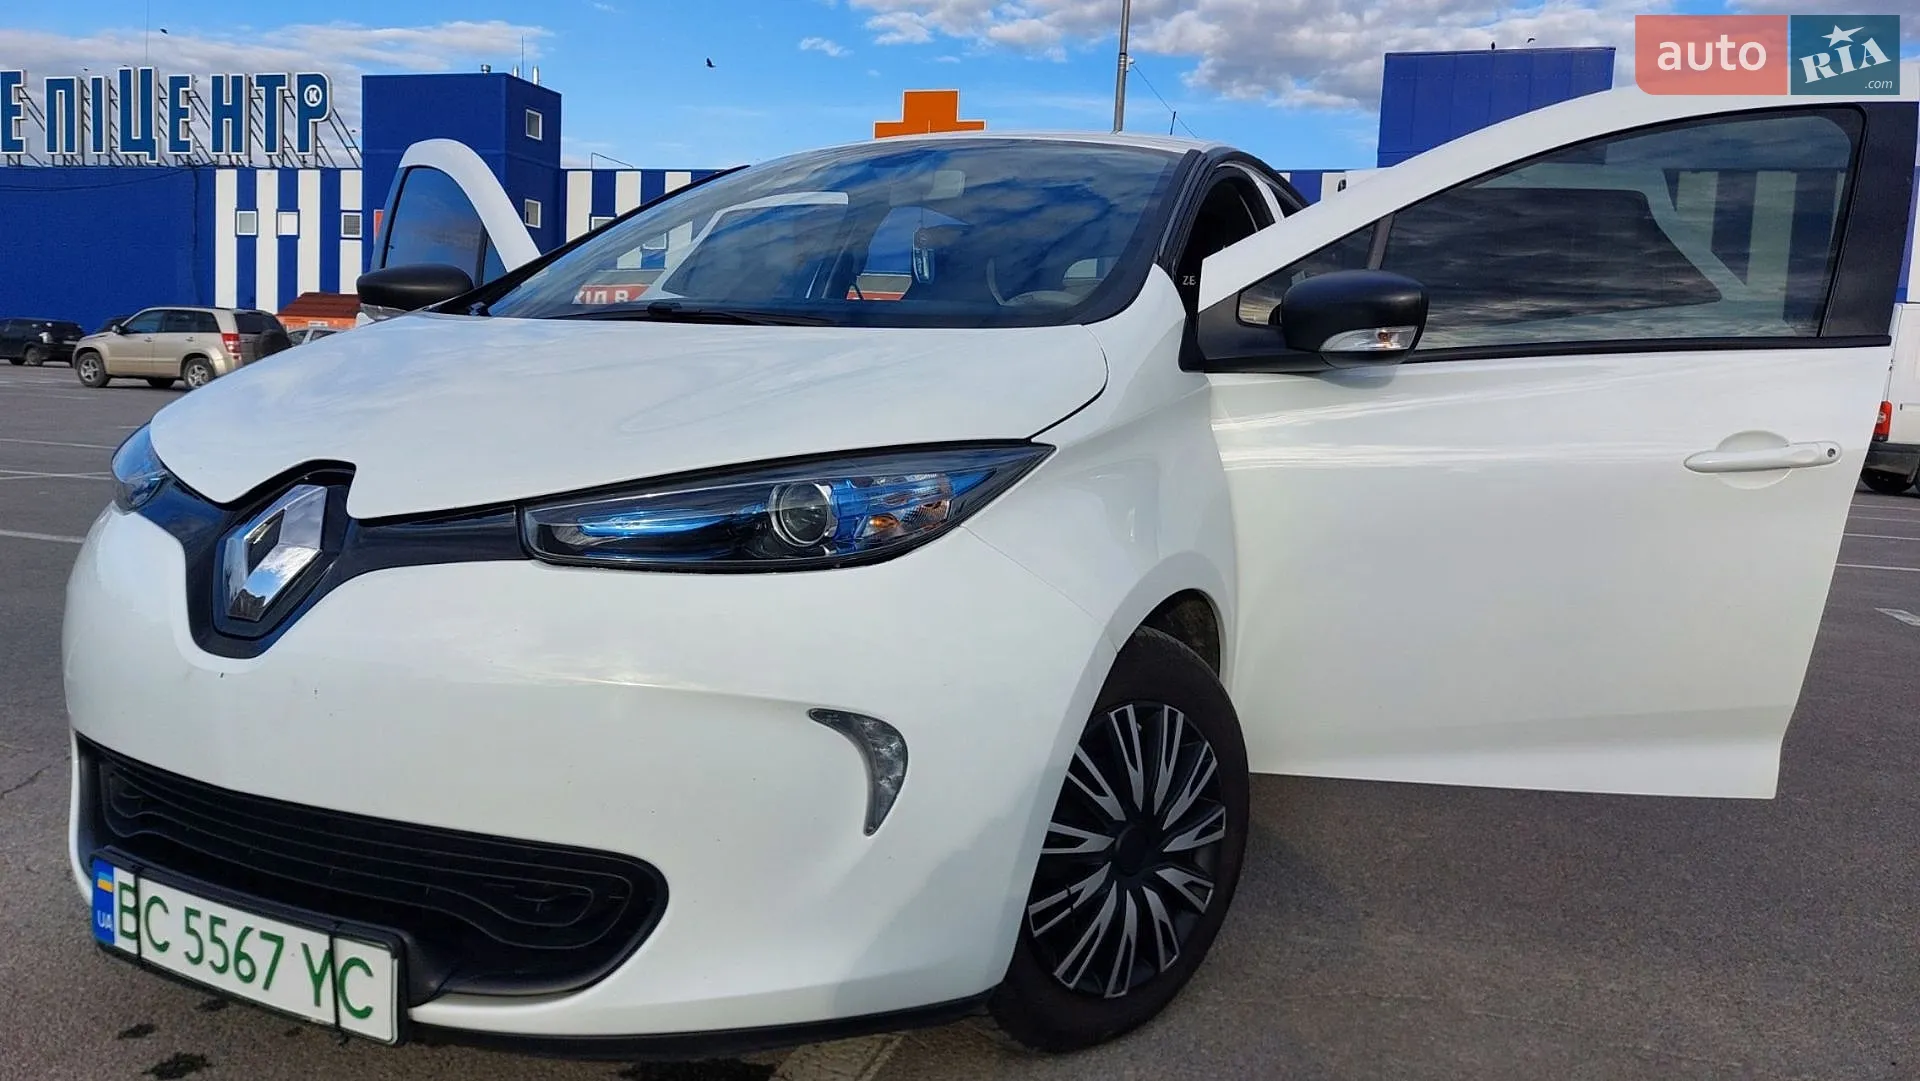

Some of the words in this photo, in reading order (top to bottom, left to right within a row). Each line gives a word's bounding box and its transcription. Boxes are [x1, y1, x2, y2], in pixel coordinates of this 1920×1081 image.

[0, 67, 331, 164] ЕПІЦЕНТР
[97, 909, 113, 932] UA
[184, 905, 284, 992] 5567
